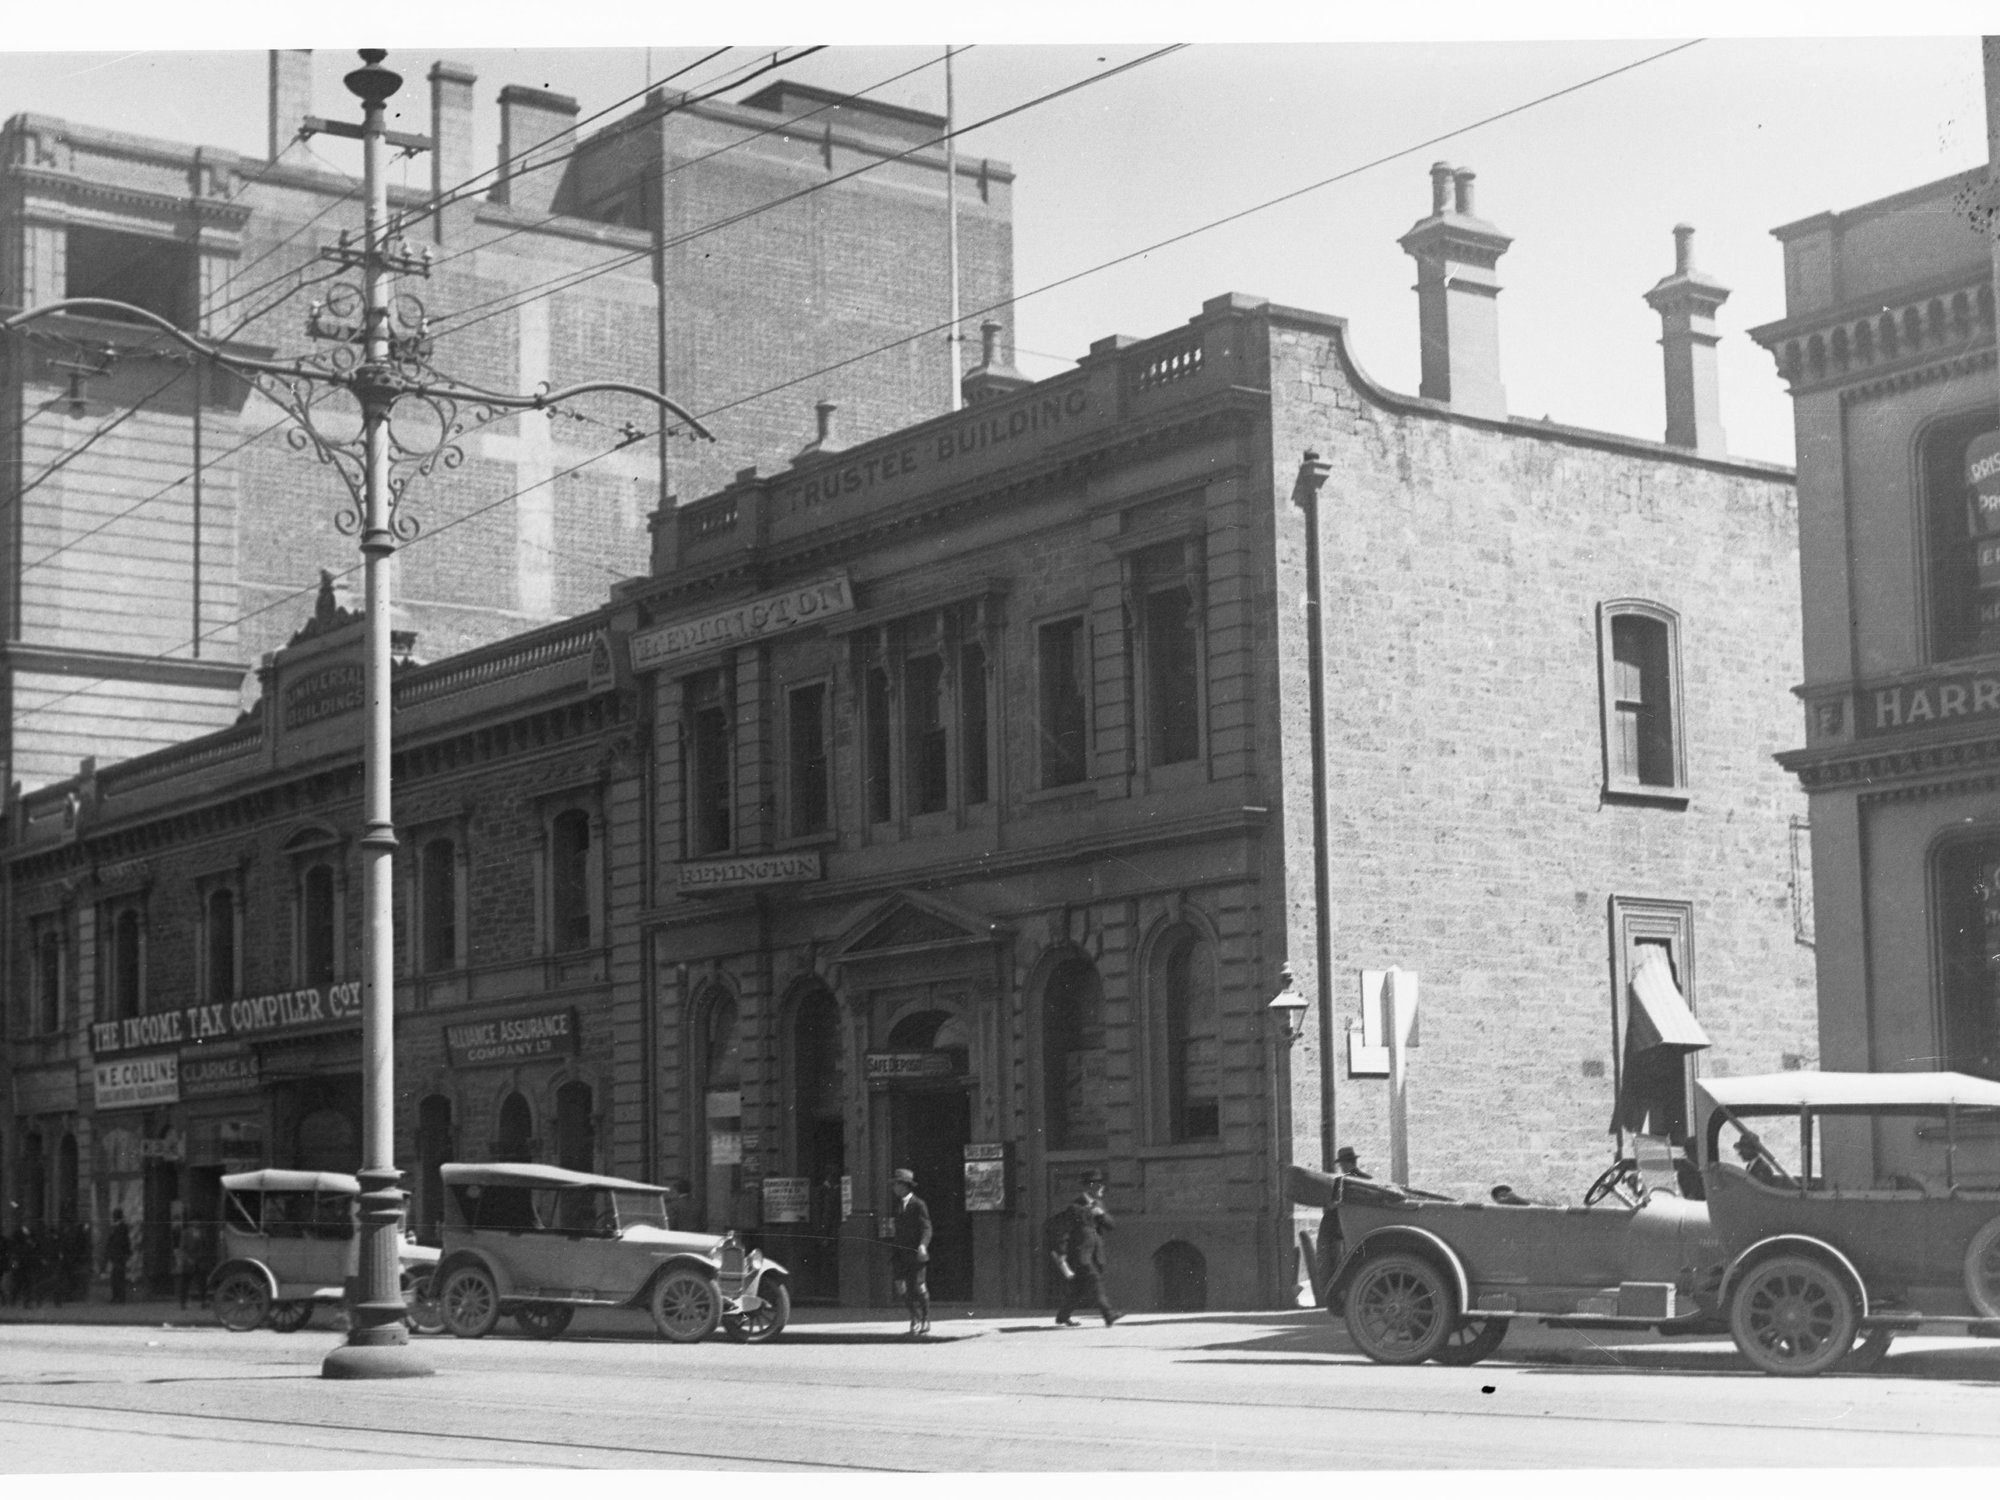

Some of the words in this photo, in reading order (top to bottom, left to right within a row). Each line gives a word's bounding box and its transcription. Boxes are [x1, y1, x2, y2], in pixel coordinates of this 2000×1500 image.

[787, 447, 918, 511] TRUSTEE
[937, 388, 1087, 463] BUILDING
[638, 582, 845, 662] REMINGTON
[680, 858, 817, 885] REMINGTON
[93, 1021, 120, 1052] THE
[123, 1011, 182, 1048] INCOME
[187, 1003, 227, 1038] TAX
[230, 989, 324, 1031] COMPILER
[447, 1024, 498, 1048] ALLIANCE
[500, 1013, 569, 1042] ASSURANCE
[467, 1042, 533, 1061] COMPANY
